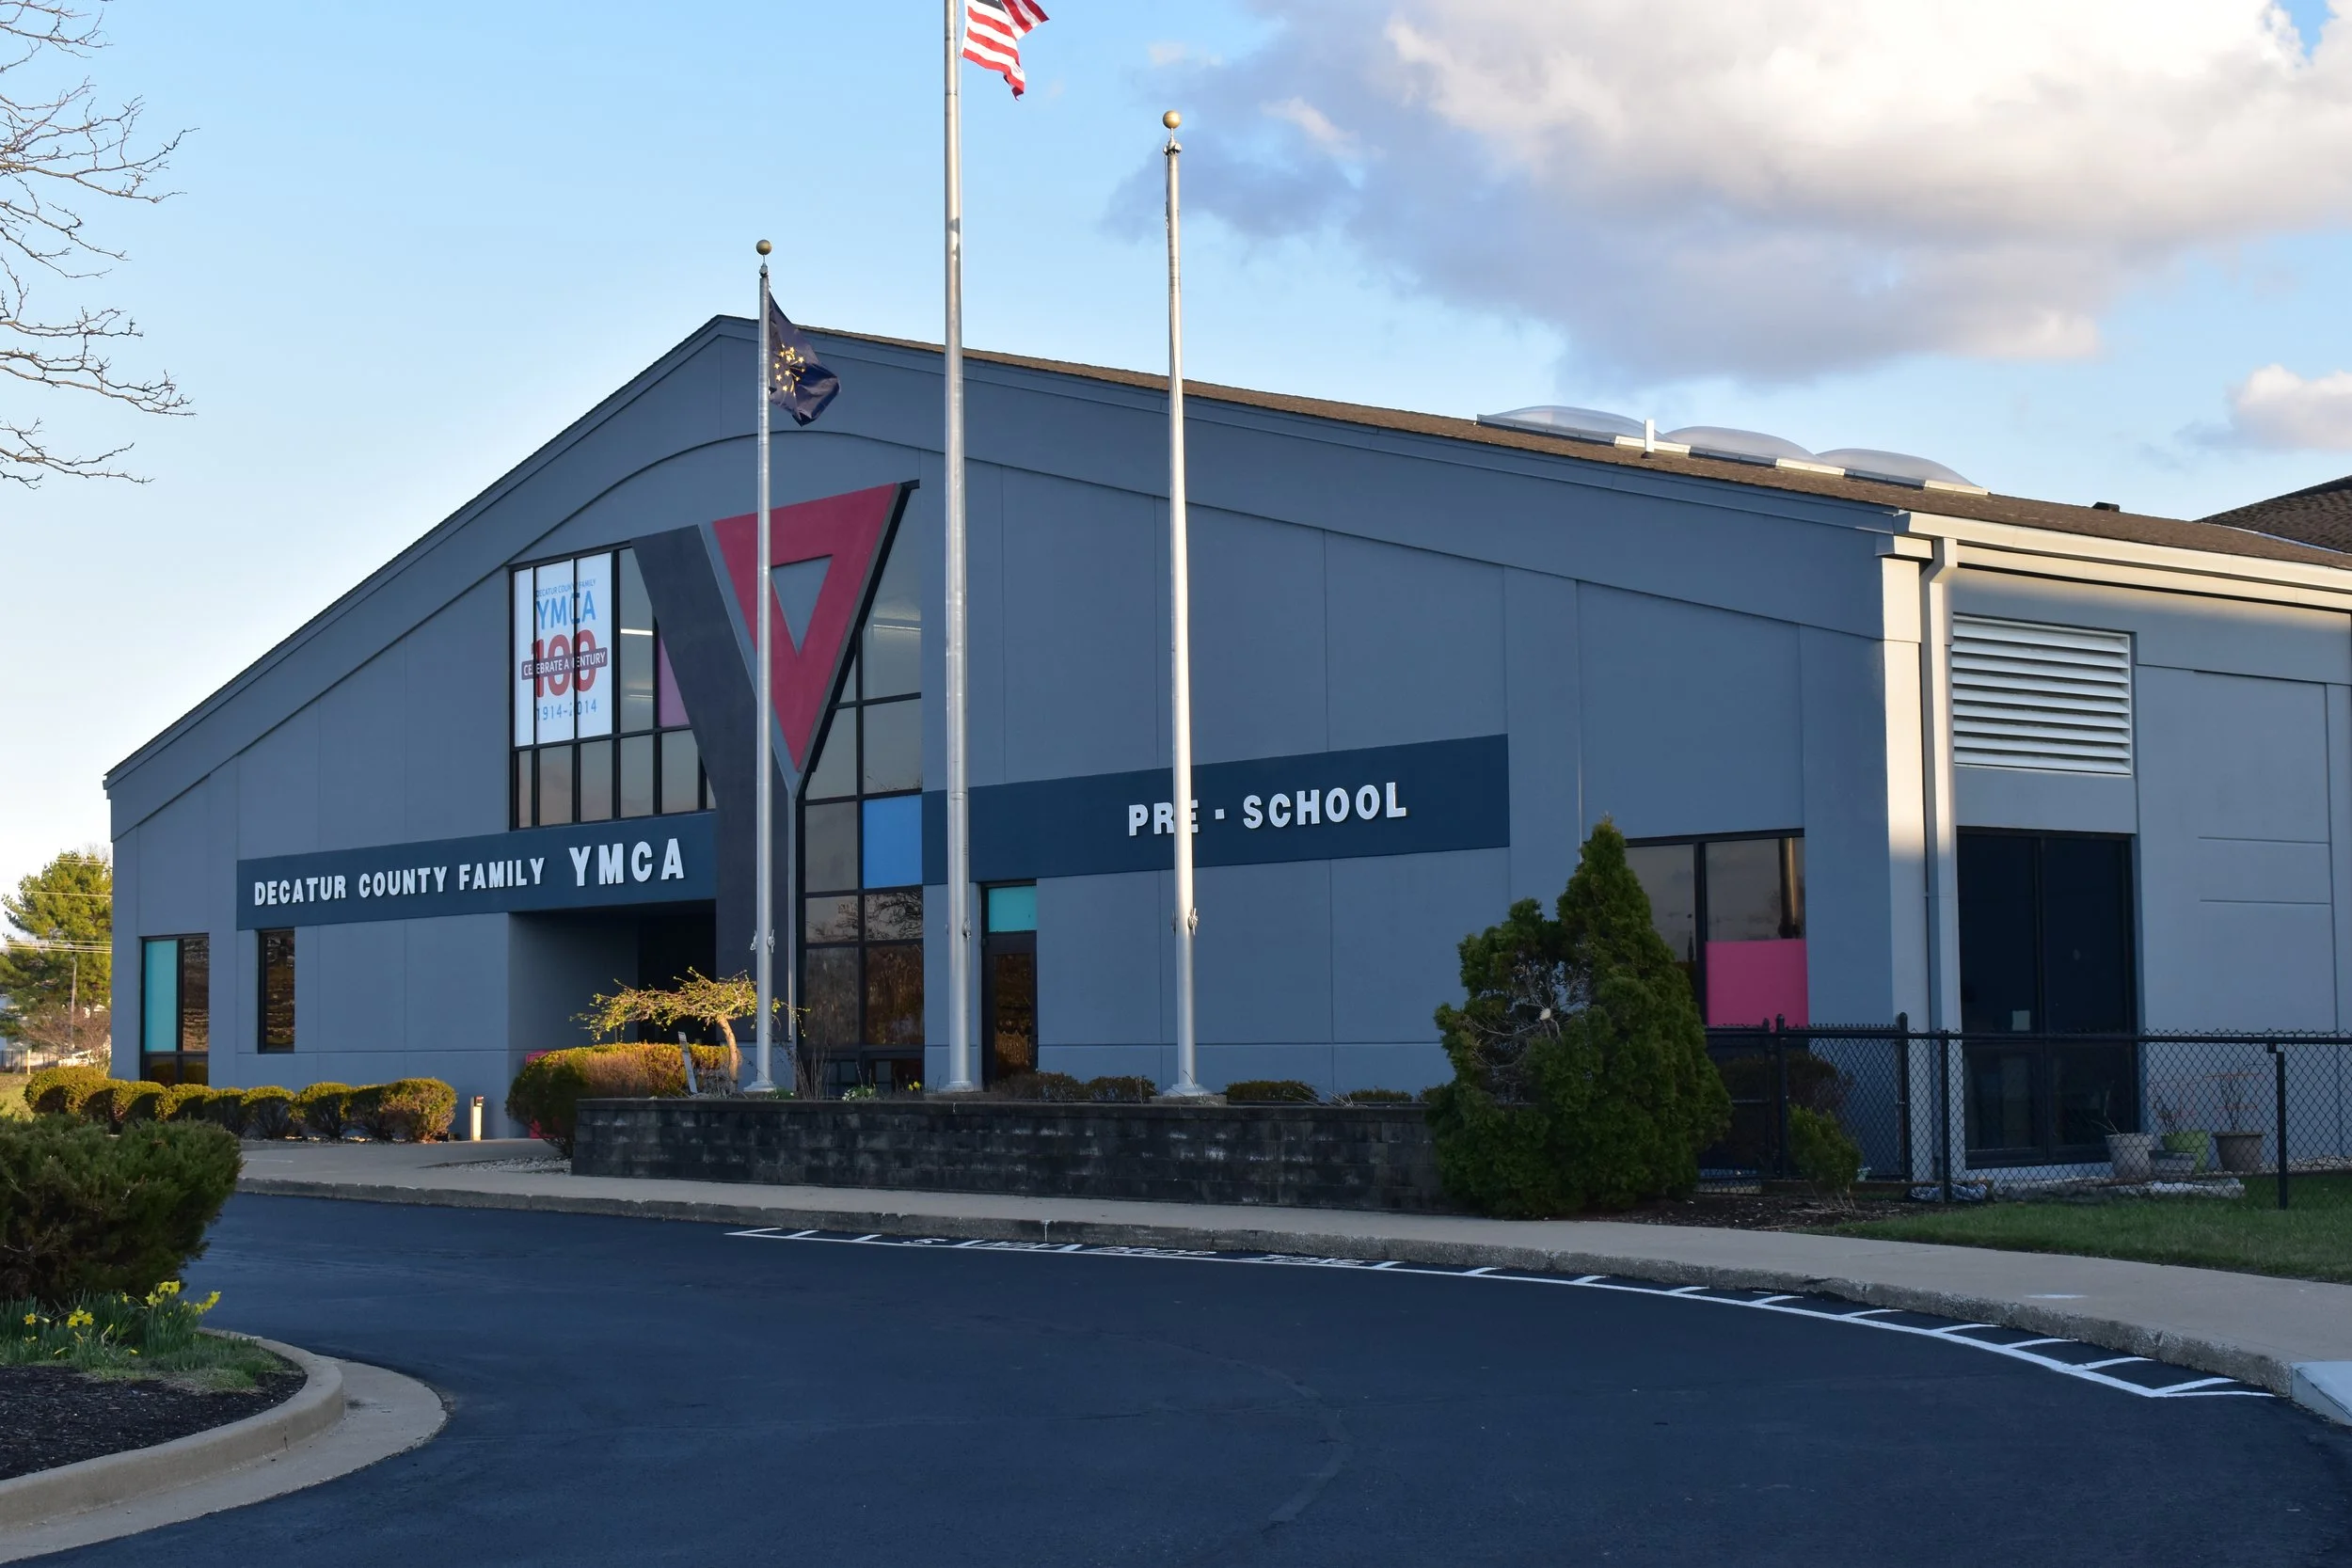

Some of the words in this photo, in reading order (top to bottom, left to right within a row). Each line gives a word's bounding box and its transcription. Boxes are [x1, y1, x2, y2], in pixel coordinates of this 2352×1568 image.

[536, 586, 557, 597] DECATUR
[558, 581, 576, 594] COUN
[579, 578, 596, 589] FAMILY
[536, 590, 596, 630] YMCA
[523, 659, 563, 676] CEEBRATE
[564, 658, 569, 670] A
[532, 629, 596, 698] 100
[1243, 782, 1406, 829] SCHOOL
[254, 875, 346, 906] DECATUR
[358, 866, 448, 898] COUNTY
[459, 857, 545, 891] FAMILY
[568, 838, 684, 887] YMCA
